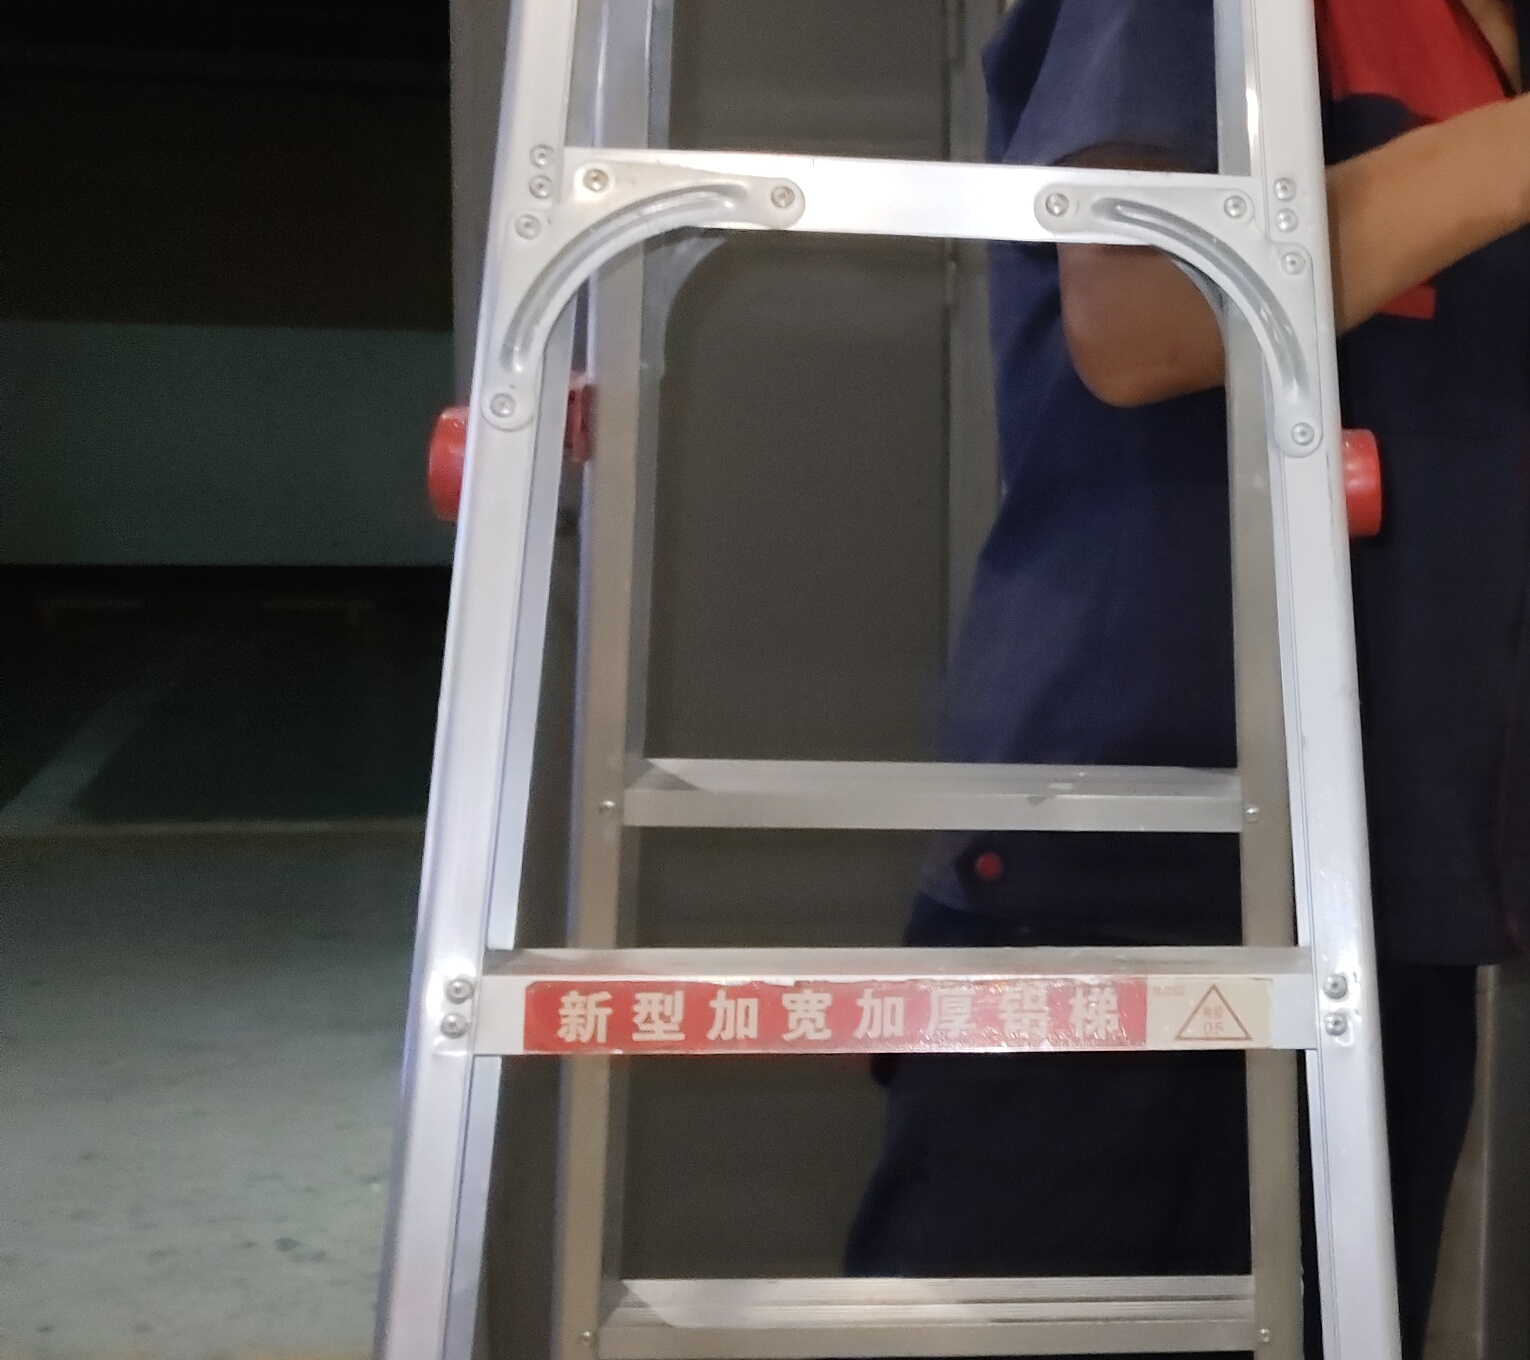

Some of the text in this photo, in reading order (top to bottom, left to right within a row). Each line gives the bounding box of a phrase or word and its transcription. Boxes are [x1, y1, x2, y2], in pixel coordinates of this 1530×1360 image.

[556, 987, 1120, 1043] 新型加宽加厚铝梯
